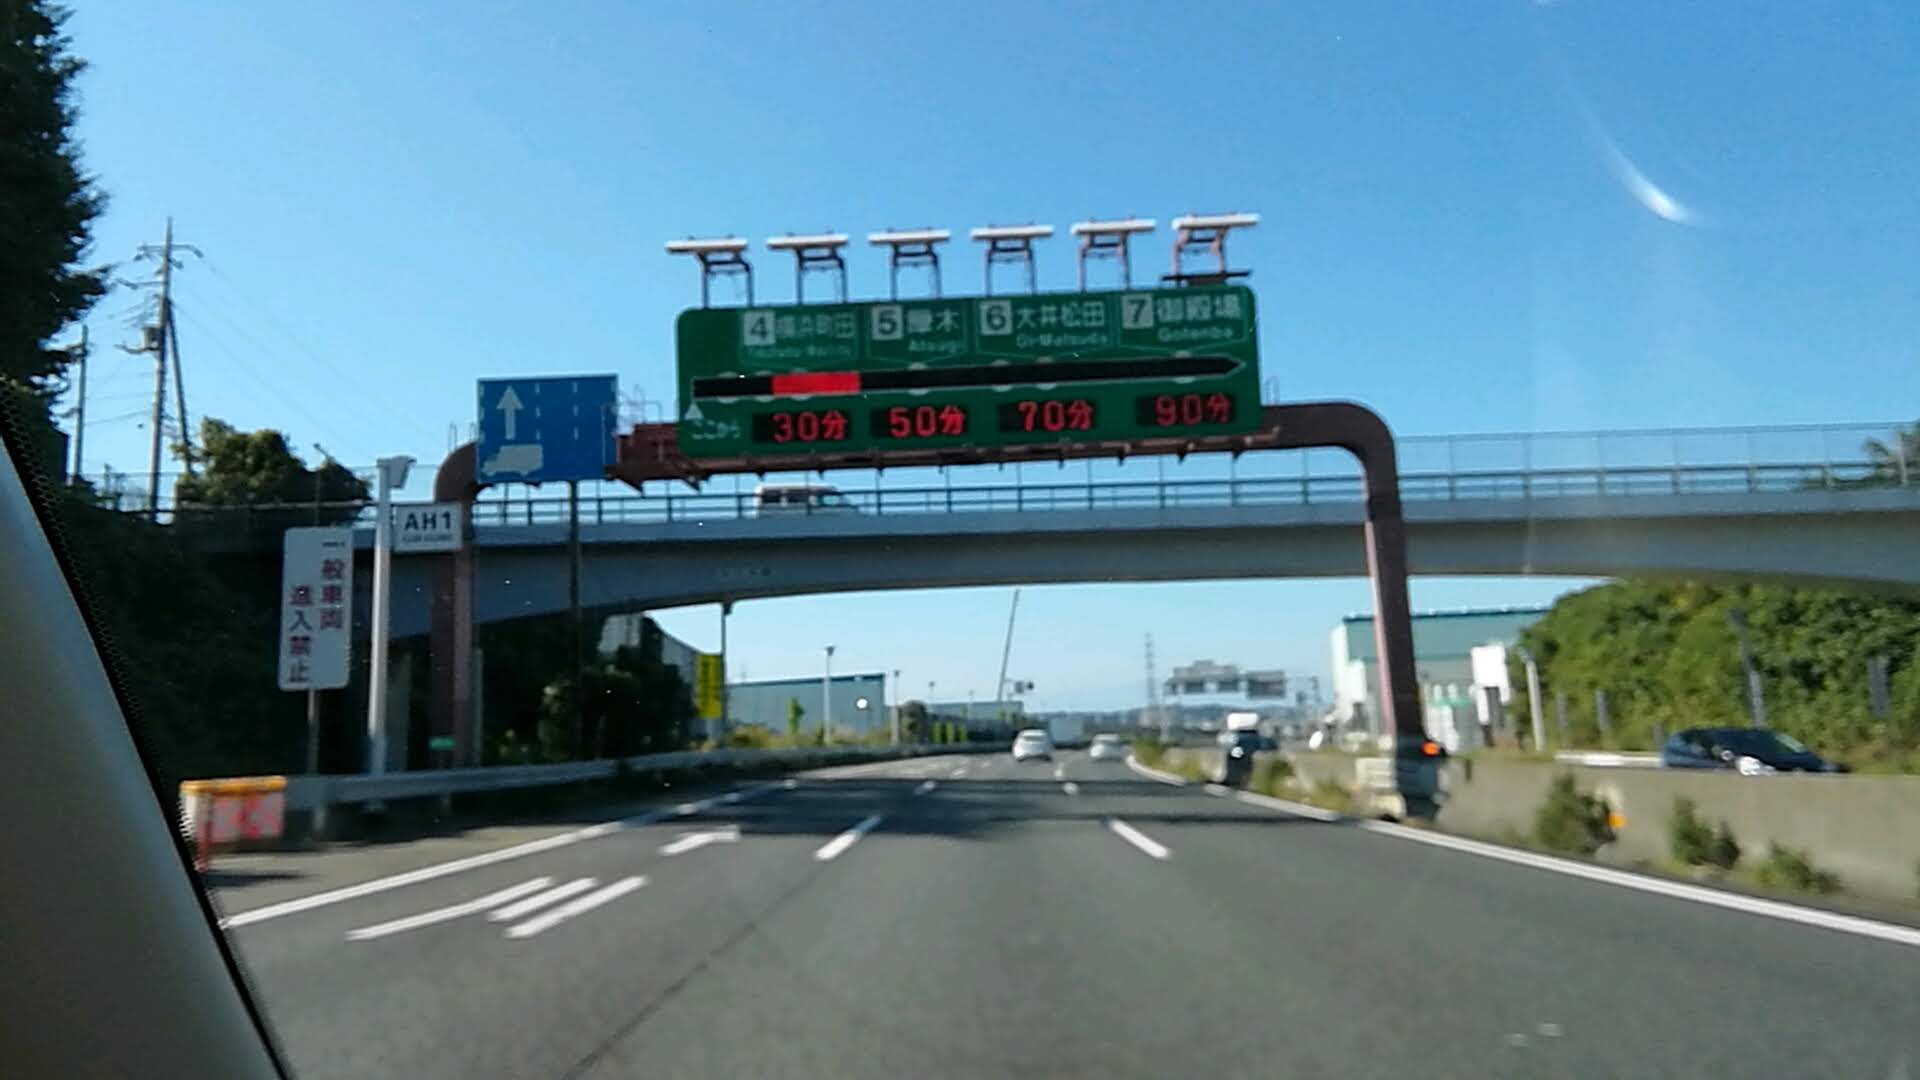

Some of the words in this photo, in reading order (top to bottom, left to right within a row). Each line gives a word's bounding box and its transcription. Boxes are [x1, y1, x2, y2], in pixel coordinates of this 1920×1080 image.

[878, 309, 898, 335] 5
[986, 304, 1008, 330] 6
[1016, 301, 1105, 328] 大井松田
[1127, 298, 1147, 324] 7
[750, 313, 768, 339] 4
[888, 405, 966, 438] 50分
[1018, 399, 1094, 432] 70分
[1154, 392, 1232, 427] 90分
[772, 410, 848, 442] 30分
[404, 511, 451, 531] AH1
